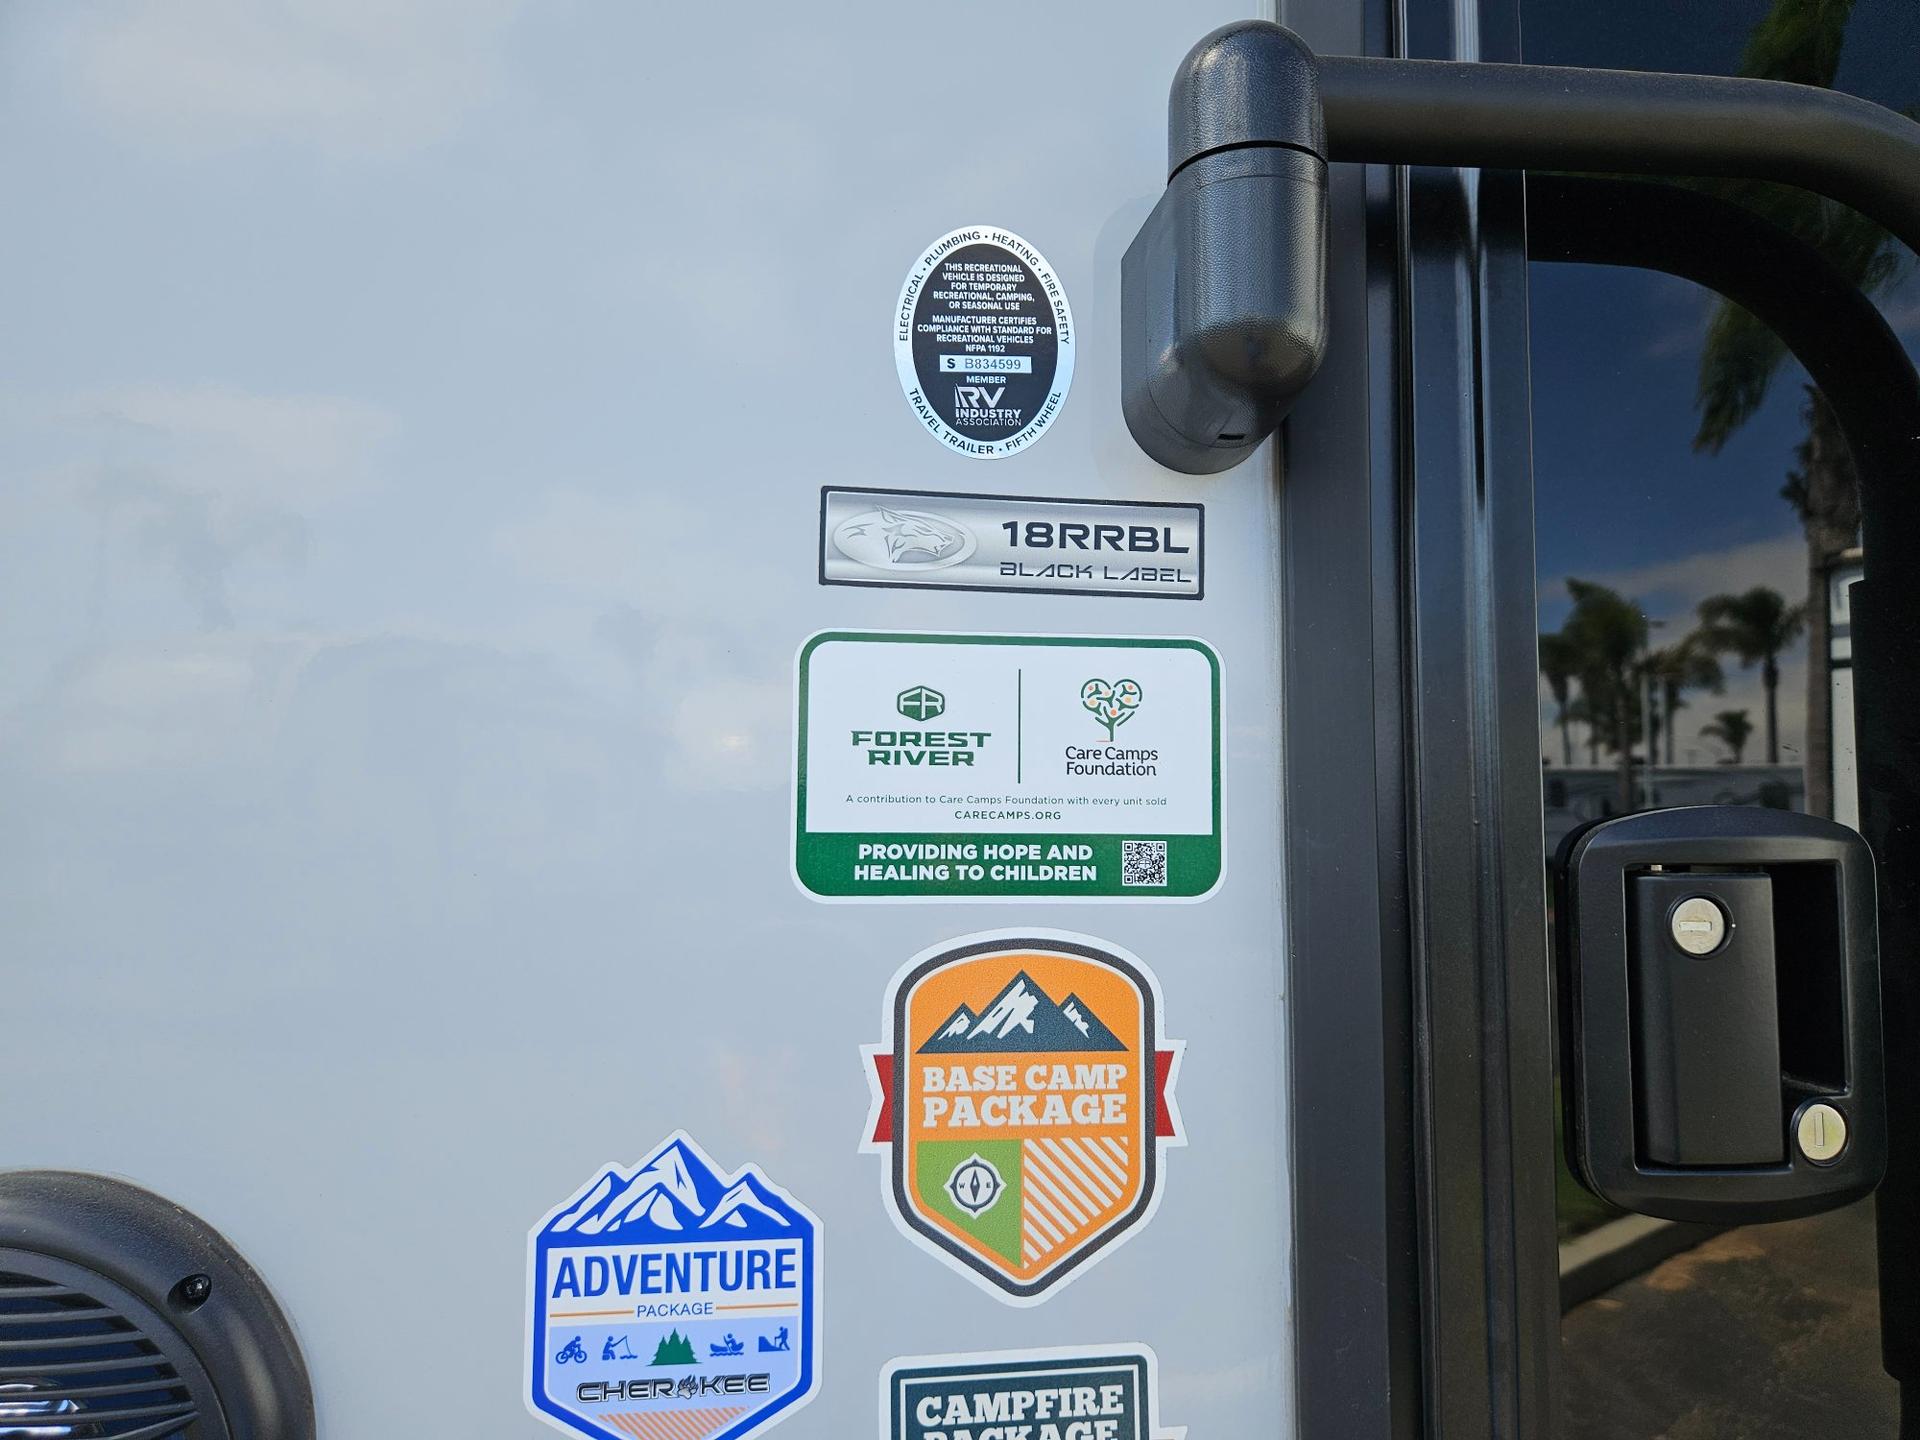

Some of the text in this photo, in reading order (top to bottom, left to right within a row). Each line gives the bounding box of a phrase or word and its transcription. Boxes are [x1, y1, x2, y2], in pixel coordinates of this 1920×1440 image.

[945, 263, 1022, 272] THIS RECREATIONAL
[943, 272, 1024, 282] VEHICLE IS DESIGNED
[900, 231, 1069, 344] ELECTRICAL PLUMBING HEATING FIRE SAFETY
[969, 283, 1017, 291] TEMPORARY
[996, 293, 1035, 302] CAMPING,
[949, 301, 960, 309] OR
[962, 302, 1003, 310] SEASONAL
[933, 315, 1036, 325] MANUFACTURER CERTIFIES
[918, 325, 969, 333] COMPLIANCE
[971, 325, 991, 333] WITH
[993, 326, 1033, 334] STANDARD
[937, 334, 1033, 343] RECREATIONAL VEHICLES
[947, 358, 1021, 369] S B834599
[955, 384, 1006, 408] RV
[956, 409, 1021, 418] INDUSTRY
[910, 388, 1061, 454] TRAVEL TRAILER FIFTH WHEEL
[956, 418, 1021, 426] ASSOCIATION
[1002, 521, 1190, 553] 18RRBL
[1000, 562, 1192, 582] BLACK LABEL
[851, 730, 991, 748] FOREST
[867, 749, 975, 766] RIVER
[1066, 746, 1159, 762] Care Camps
[1067, 762, 1157, 776] Foundation
[846, 795, 853, 803] A
[857, 795, 921, 803] contribution
[967, 796, 1001, 805] Camps
[1005, 796, 1063, 804] Foundation
[1068, 796, 1088, 804] with
[1092, 798, 1120, 806] every
[1124, 797, 1142, 805] unit
[1146, 797, 1167, 805] sold
[955, 810, 1061, 820] CARECAMPS.ORG
[859, 845, 1093, 861] PROVIDING HOPE AND
[855, 865, 1096, 881] HEALING TO CHILDREN
[923, 1064, 1128, 1092] BASE CAMP
[923, 1094, 1127, 1127] PACKAGE
[552, 1248, 796, 1298] ADVENTURE
[637, 1303, 714, 1317] PACKAGE
[916, 1385, 1123, 1426] CAMPFIRE
